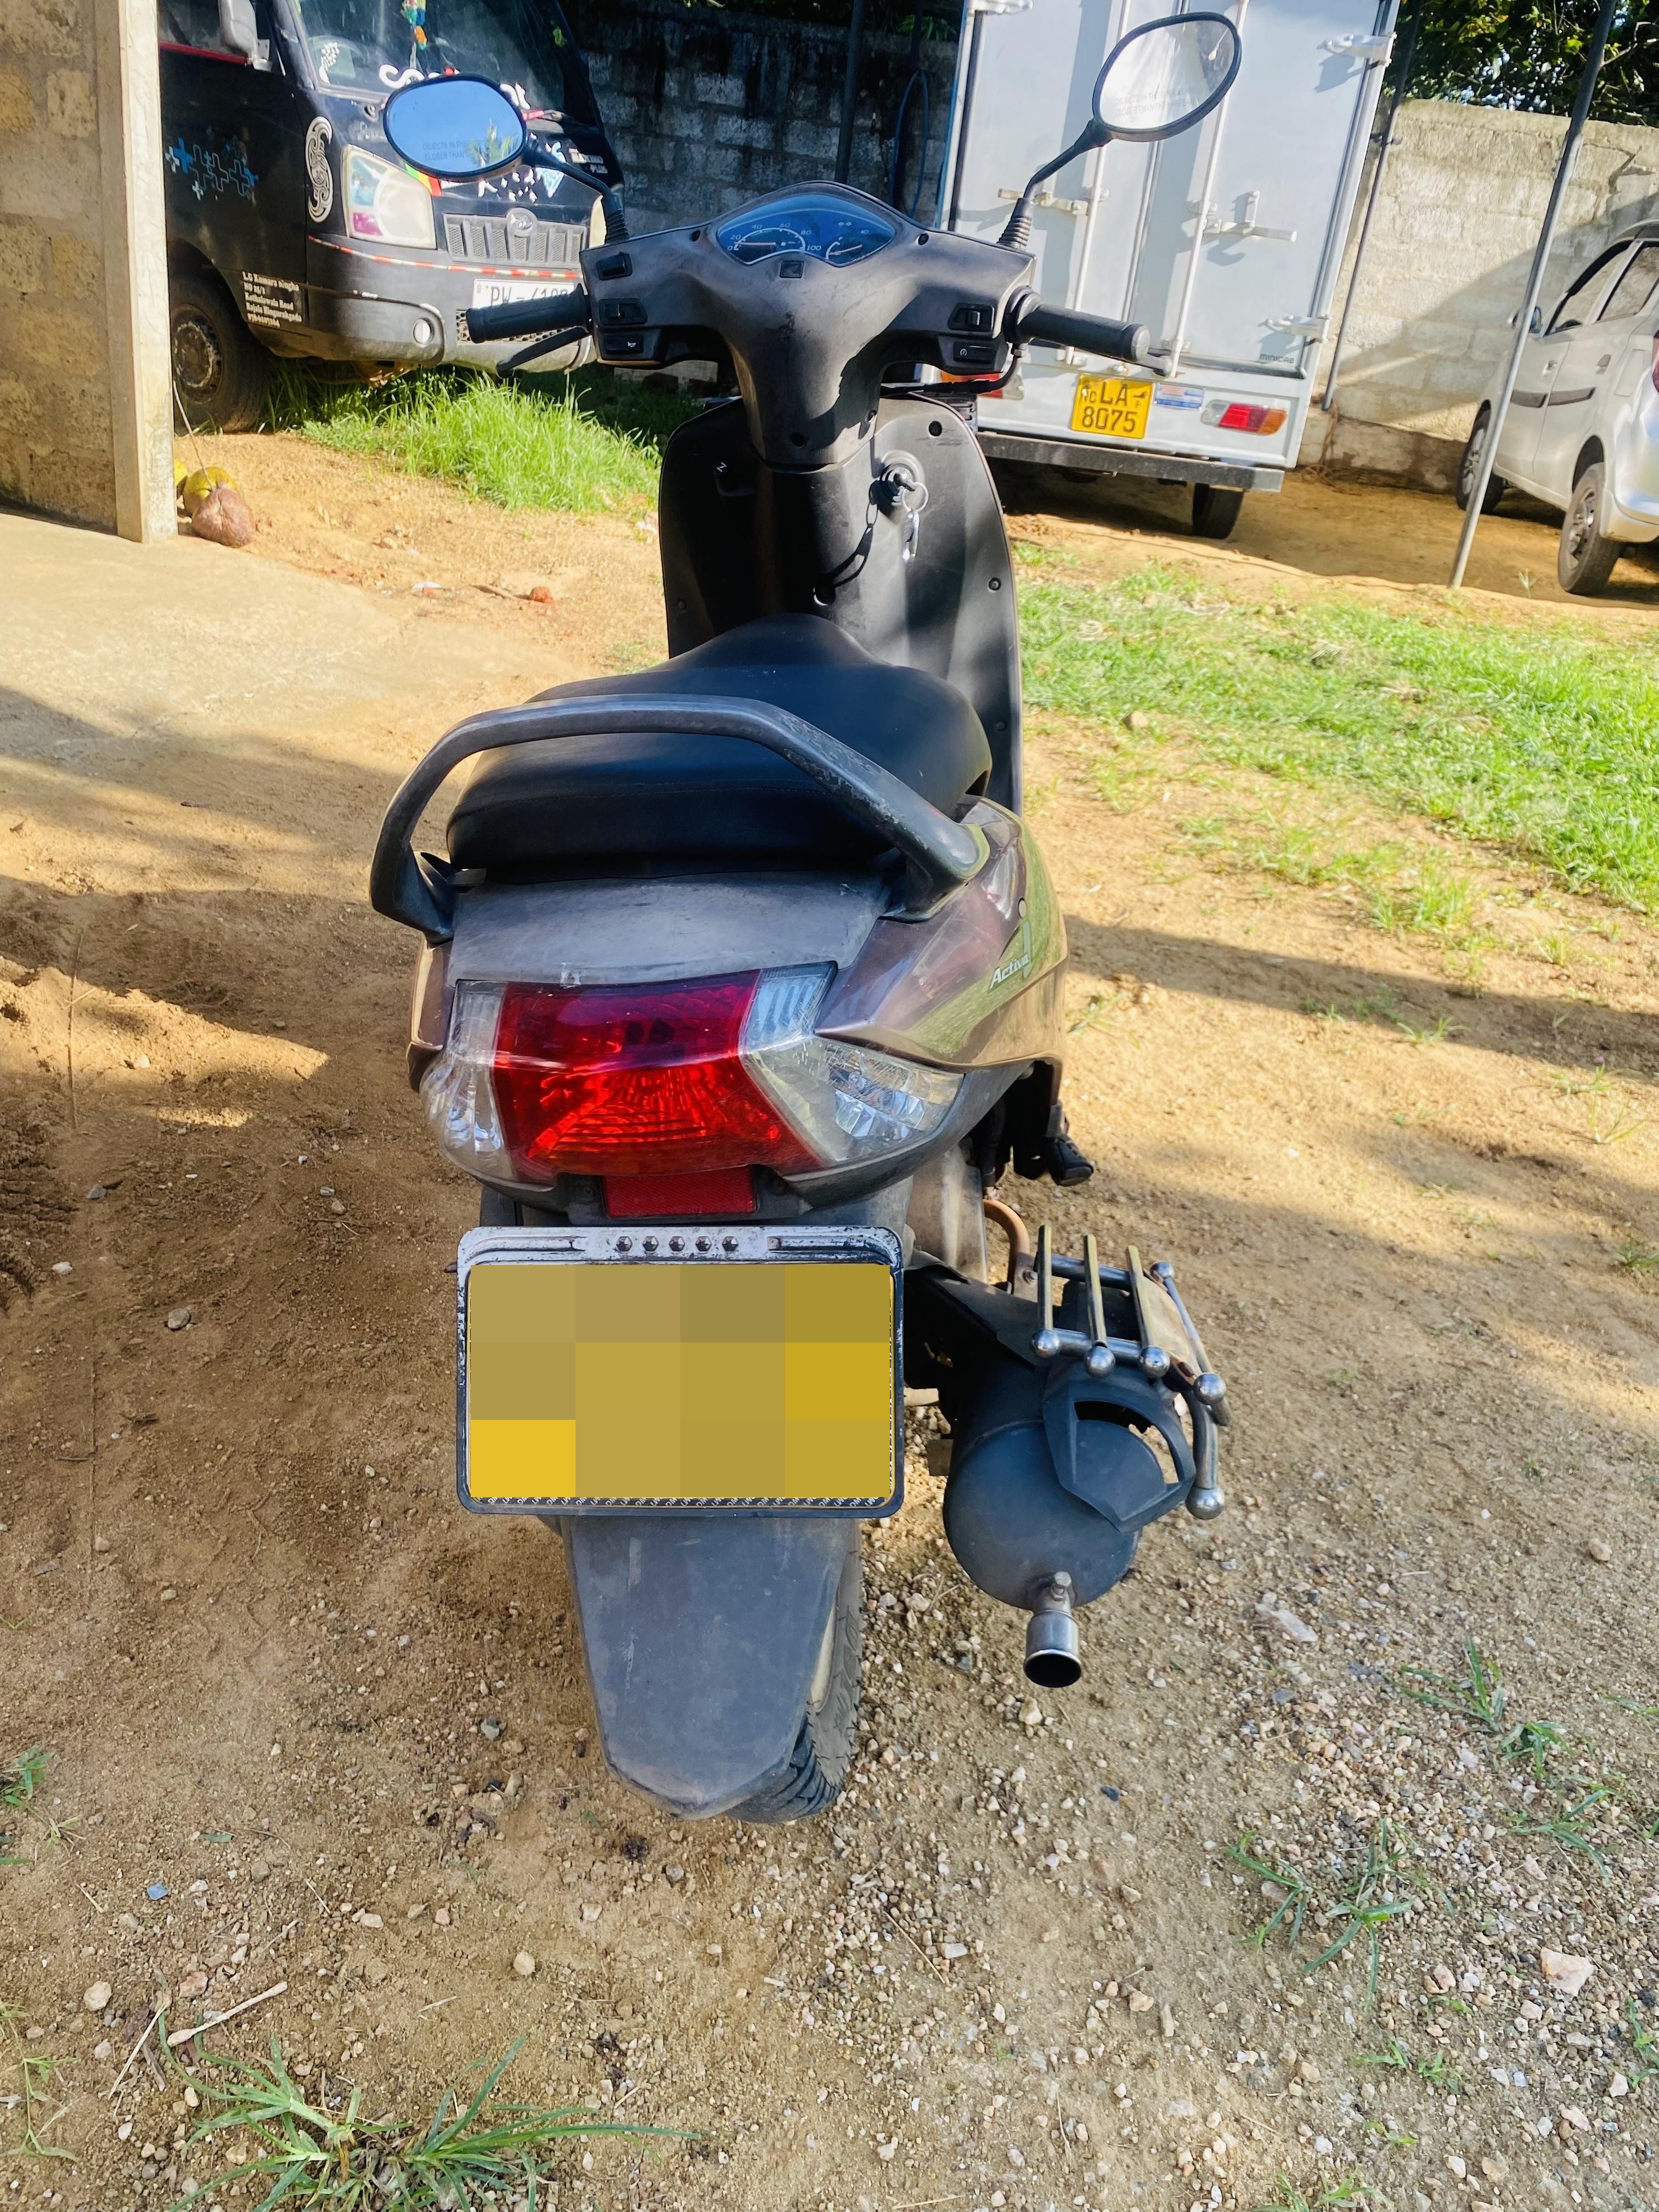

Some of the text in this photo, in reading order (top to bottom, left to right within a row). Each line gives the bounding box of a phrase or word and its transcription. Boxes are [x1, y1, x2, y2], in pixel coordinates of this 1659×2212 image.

[1101, 381, 1127, 406] LA
[1082, 405, 1137, 433] 8075
[989, 953, 1031, 990] Activa
